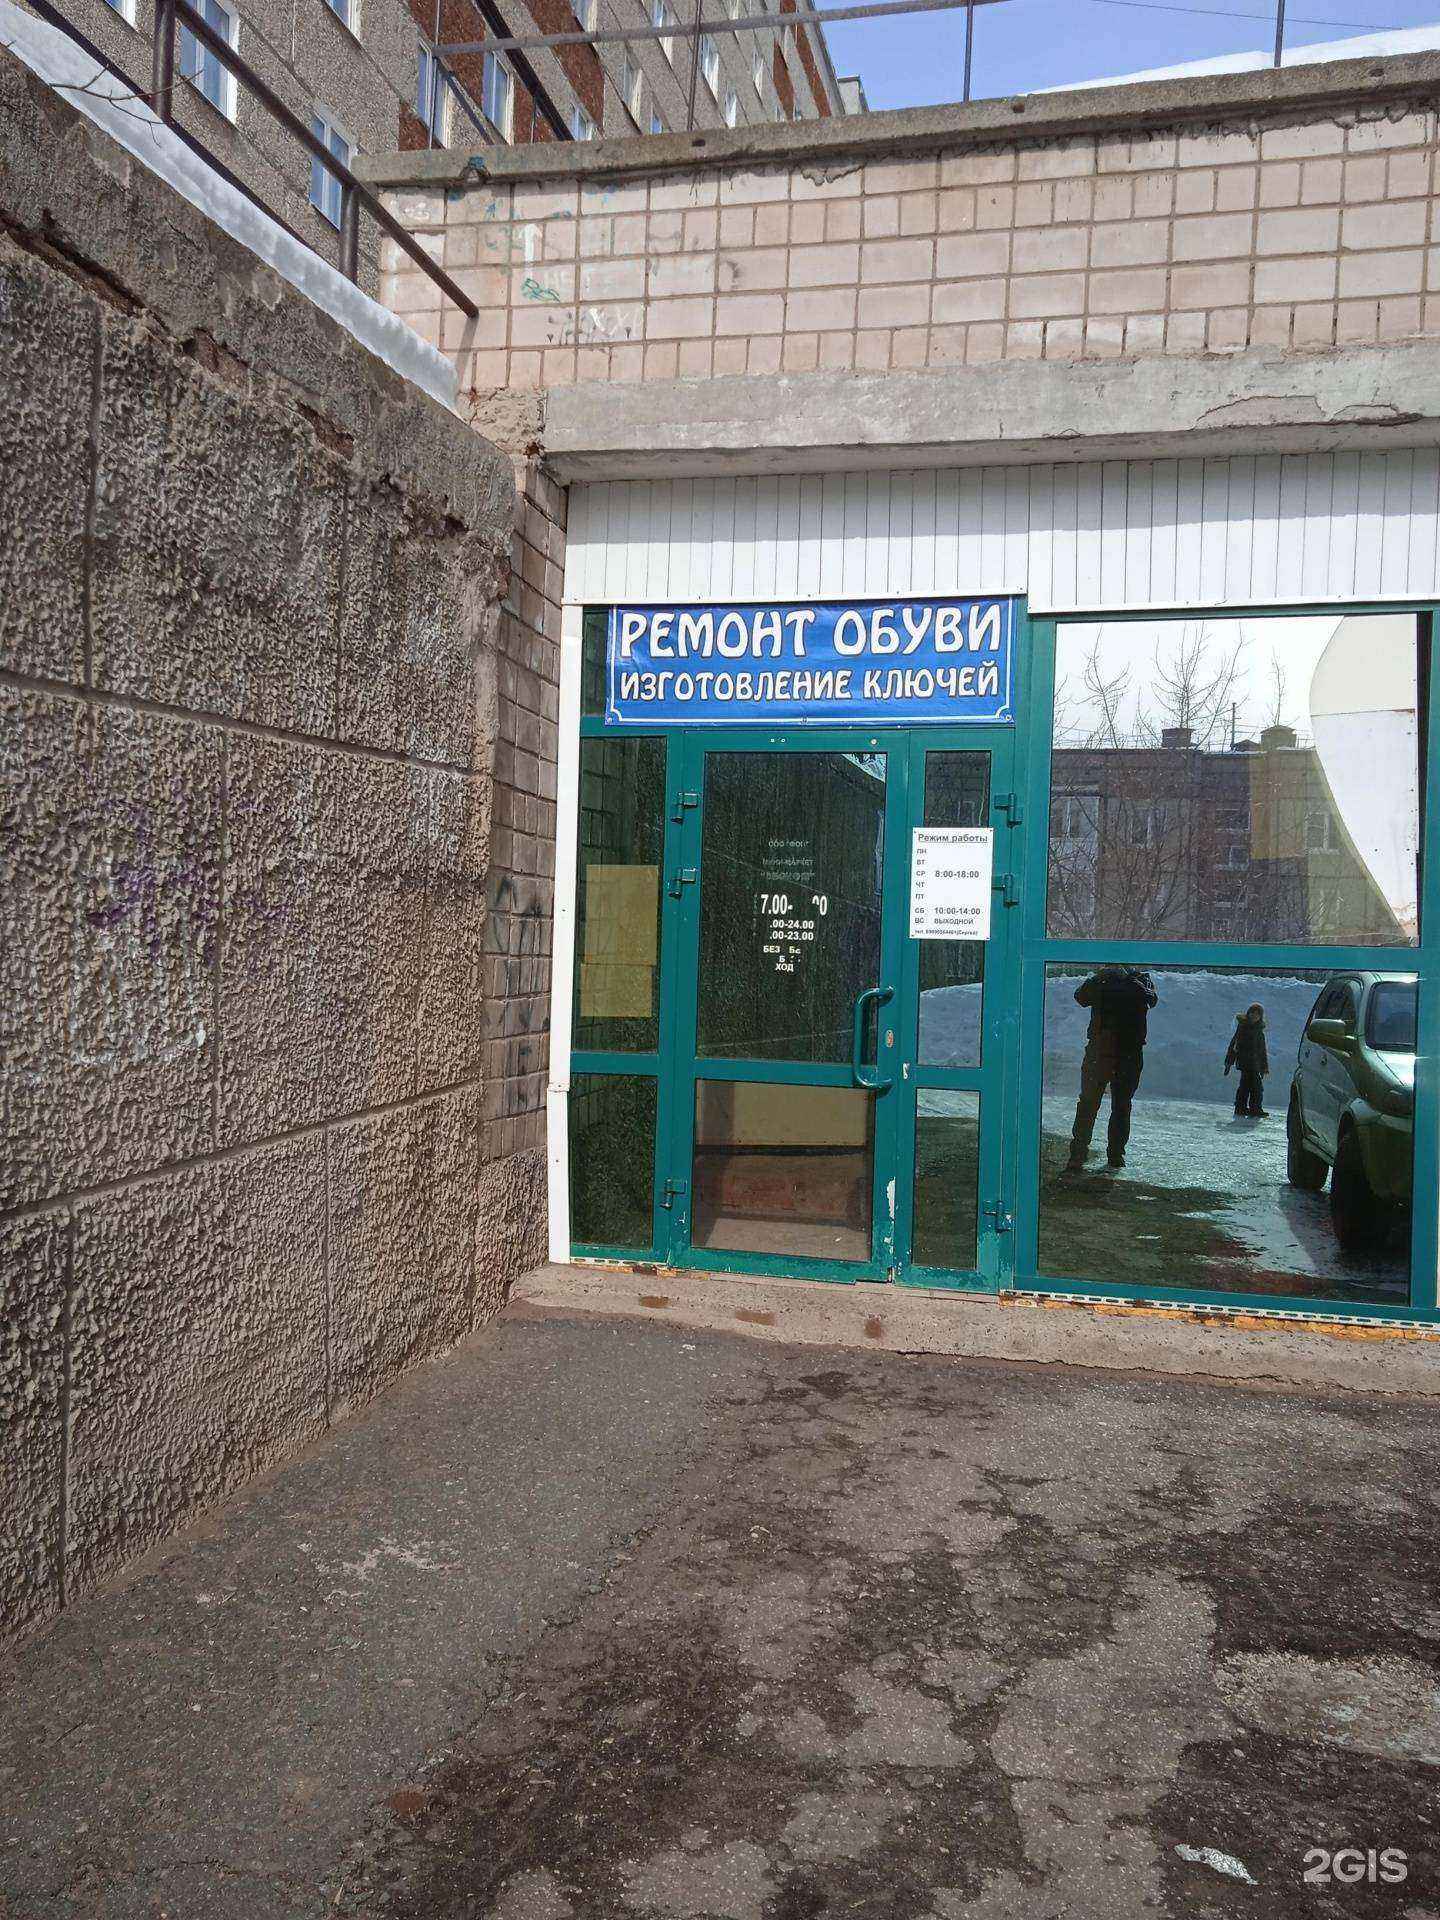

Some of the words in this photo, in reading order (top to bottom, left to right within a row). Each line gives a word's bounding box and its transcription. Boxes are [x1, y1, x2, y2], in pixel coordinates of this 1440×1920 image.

[620, 609, 816, 658] РЕМОНТ
[833, 603, 1001, 656] ОБУВИ
[620, 670, 853, 701] ИЗГОТОВЛЕНИЕ
[863, 659, 999, 700] КЛЮЧЕЙ
[918, 833, 949, 842] Режим
[952, 834, 988, 843] работы
[935, 870, 980, 878] 8:00-18:00
[934, 907, 981, 915] 10:00-14:00
